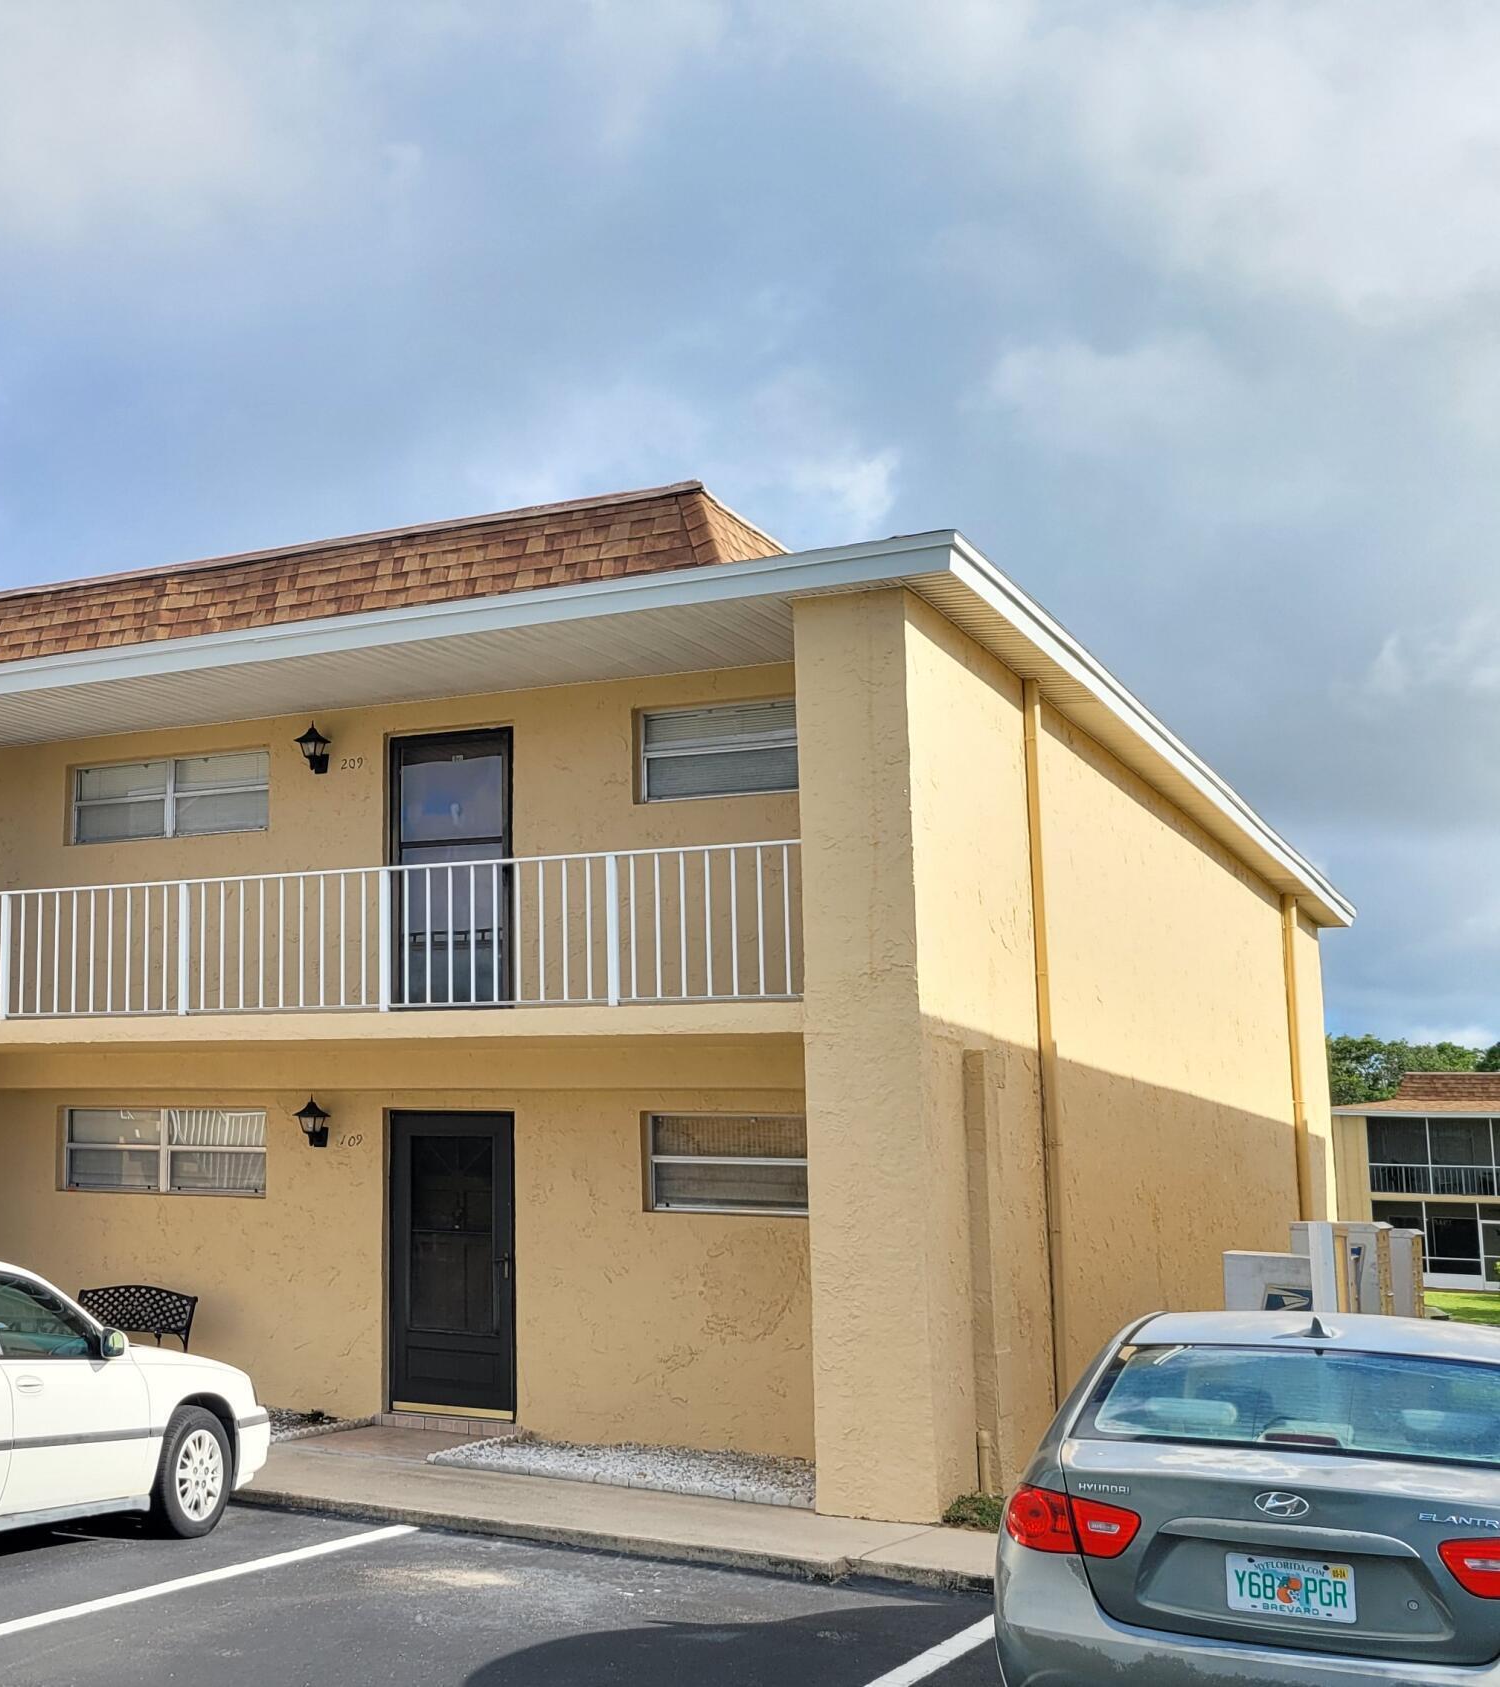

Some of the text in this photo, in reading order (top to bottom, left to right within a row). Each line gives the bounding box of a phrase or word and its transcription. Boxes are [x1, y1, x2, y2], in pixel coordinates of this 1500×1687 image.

[341, 757, 363, 770] 209
[340, 1134, 363, 1147] 109
[1078, 1483, 1130, 1495] HYUNDAI
[1253, 1560, 1326, 1577] MYFLORIDA.COM
[1234, 1569, 1348, 1608] Y68 PGR
[1262, 1602, 1320, 1616] BREVARD
